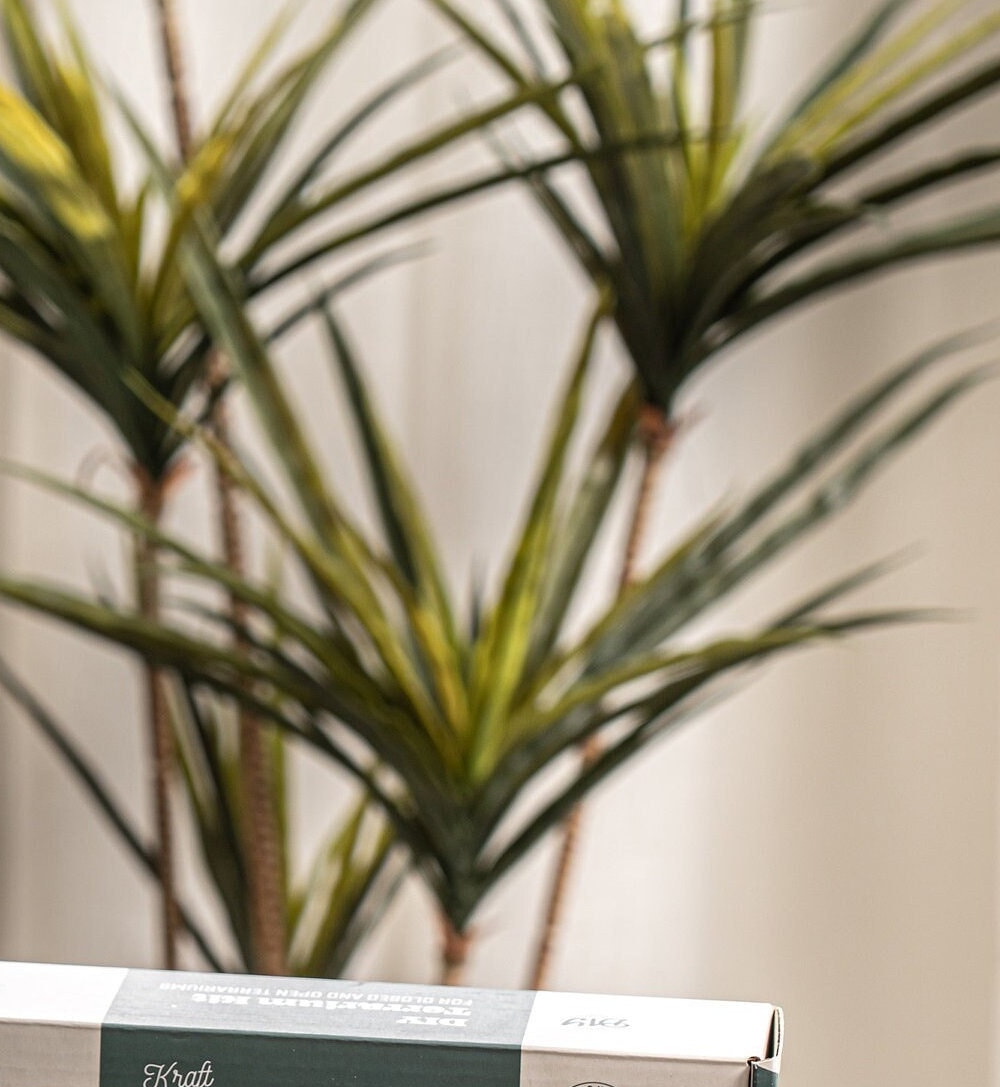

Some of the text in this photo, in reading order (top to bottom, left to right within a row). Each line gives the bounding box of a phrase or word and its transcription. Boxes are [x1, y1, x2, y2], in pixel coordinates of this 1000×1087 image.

[275, 988, 323, 999] OPEN
[326, 991, 364, 1001] AND
[257, 996, 473, 1016] Terrarium
[396, 1015, 471, 1027] DIY
